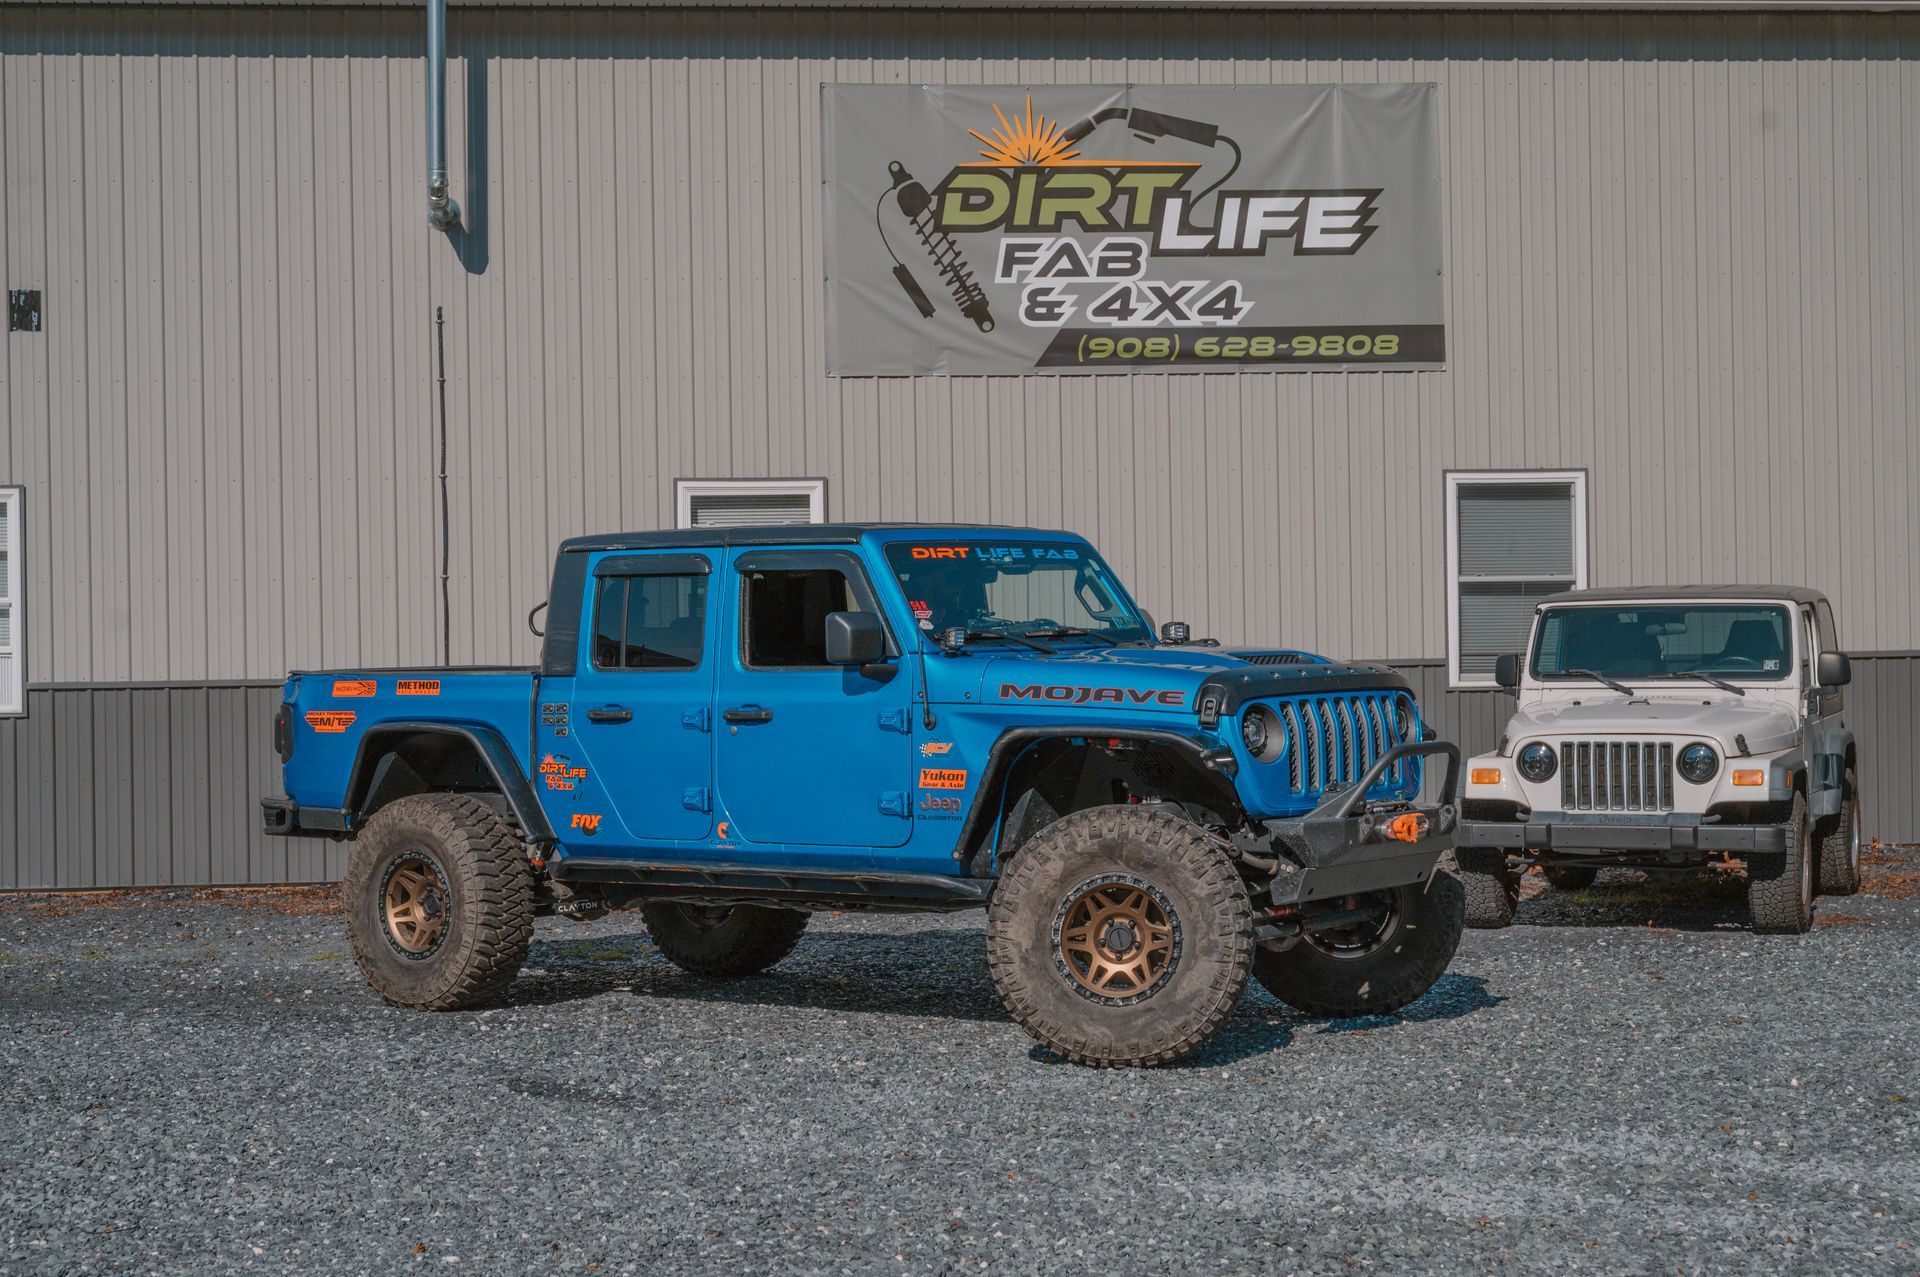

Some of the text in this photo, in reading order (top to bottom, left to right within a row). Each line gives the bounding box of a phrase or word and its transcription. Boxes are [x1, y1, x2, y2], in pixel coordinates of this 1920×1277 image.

[941, 172, 1371, 250] DIRT LIFE
[999, 241, 1145, 279] FAB
[1024, 286, 1244, 322] & 4X4
[1077, 334, 1400, 363] (908) 628-9808
[912, 547, 1080, 561] DIRT LIFE FAB
[398, 682, 439, 690] METHOD
[1000, 684, 1187, 706] MOJAVE
[319, 717, 343, 727] M/T
[540, 763, 587, 778] DIRT LIFE
[922, 770, 965, 781] Yukon
[557, 783, 574, 791] 4X4
[920, 793, 962, 814] Jeep
[571, 814, 602, 829] FOX
[557, 901, 598, 913] CLAYTON
